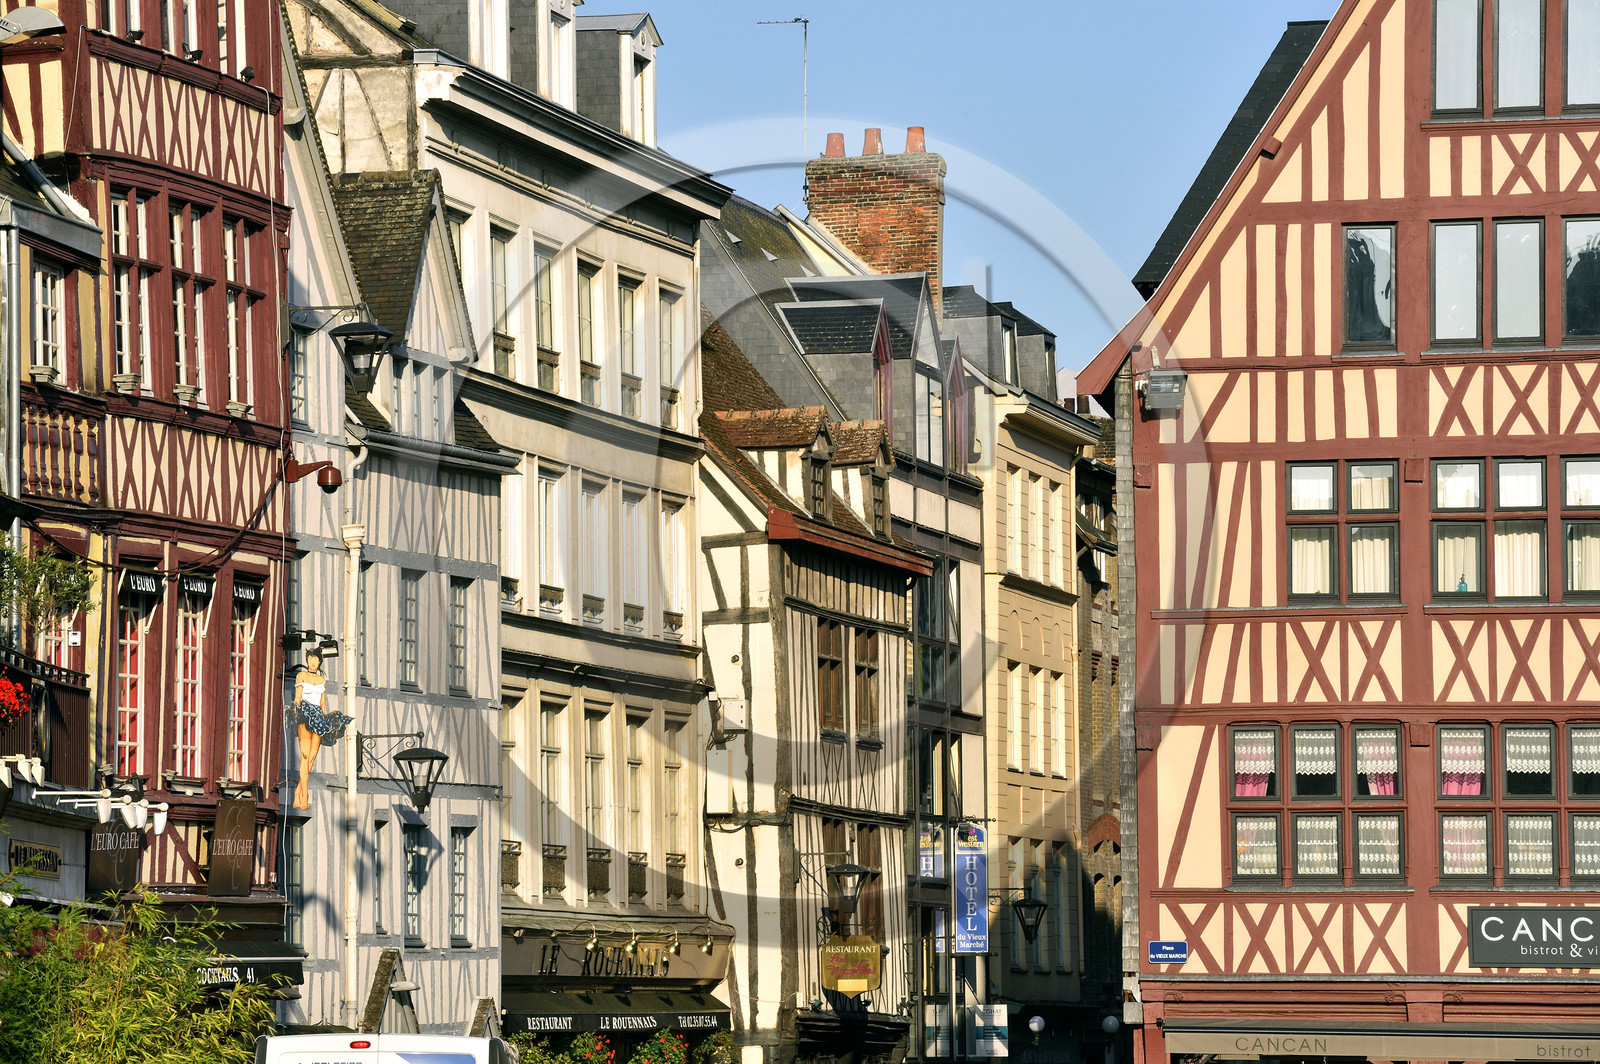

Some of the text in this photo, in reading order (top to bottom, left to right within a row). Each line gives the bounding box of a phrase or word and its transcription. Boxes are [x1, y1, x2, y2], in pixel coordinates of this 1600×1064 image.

[130, 574, 156, 593] L'EURO
[183, 577, 207, 594] L'EURO
[233, 583, 255, 600] L'EURO
[91, 832, 119, 850] L'EURO
[212, 839, 237, 856] L'EURO
[958, 840, 984, 848] Western
[965, 856, 978, 931] HOTEL
[1481, 916, 1594, 942] CANC
[825, 945, 877, 953] RESTAURANT
[960, 941, 985, 949] Marché
[1521, 944, 1563, 955] bistrot
[1570, 943, 1583, 958] &
[538, 945, 560, 975] LE
[527, 1016, 572, 1030] RESTAURANT
[600, 1016, 610, 1030] LE
[612, 1015, 657, 1030] ROUENNAIS
[1235, 1037, 1590, 1058] CANCAN bistrot
